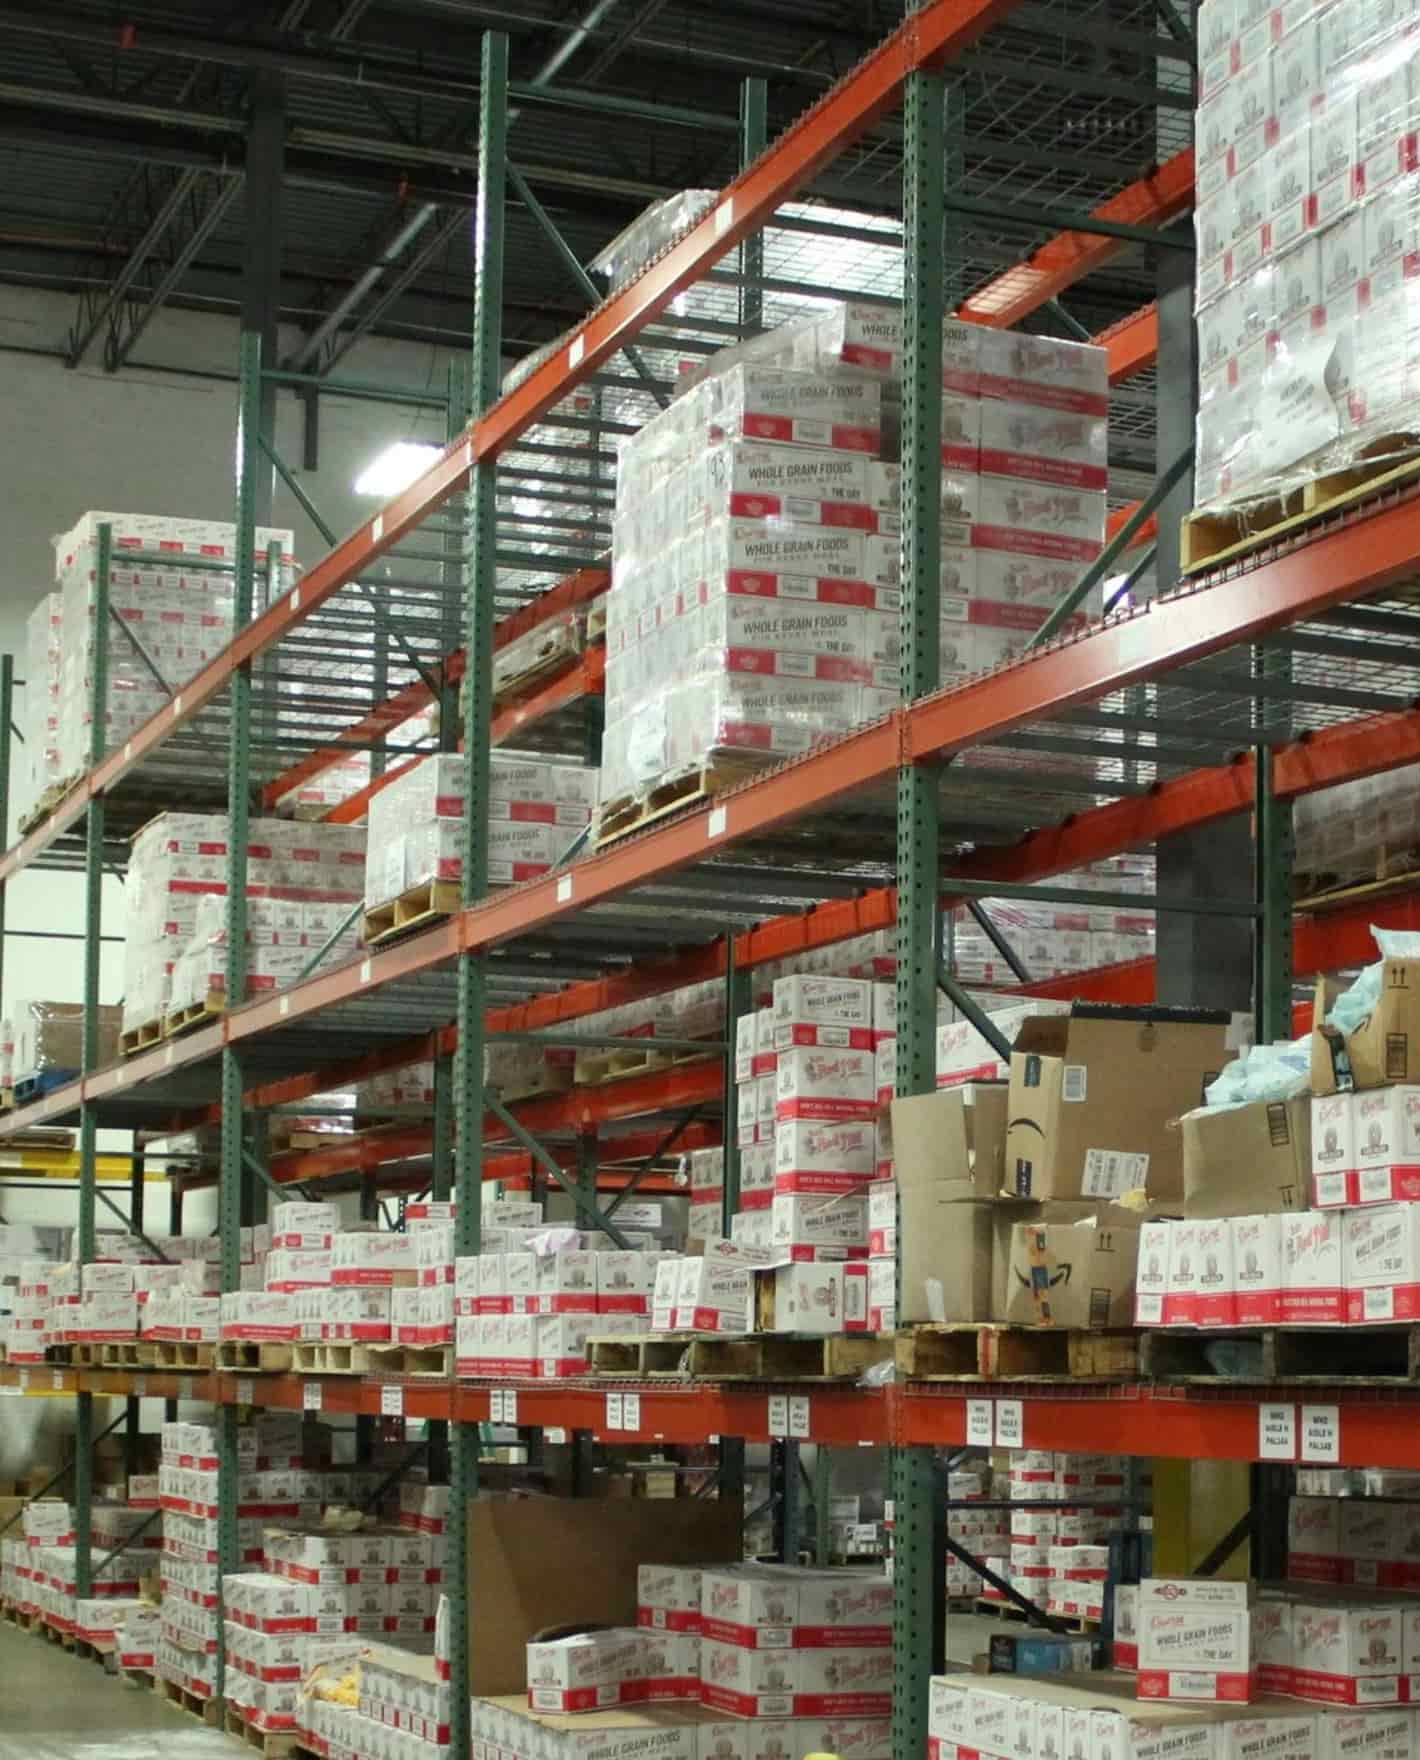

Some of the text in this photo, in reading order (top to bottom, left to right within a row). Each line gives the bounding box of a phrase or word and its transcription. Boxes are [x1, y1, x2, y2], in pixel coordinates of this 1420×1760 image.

[862, 324, 896, 337] WHOLE
[749, 461, 853, 481] WHOLE GRAIN FOODS
[745, 537, 849, 556] WHOLE GRAIN FOODS
[743, 615, 848, 635] WHOLE GRAIN FOODS
